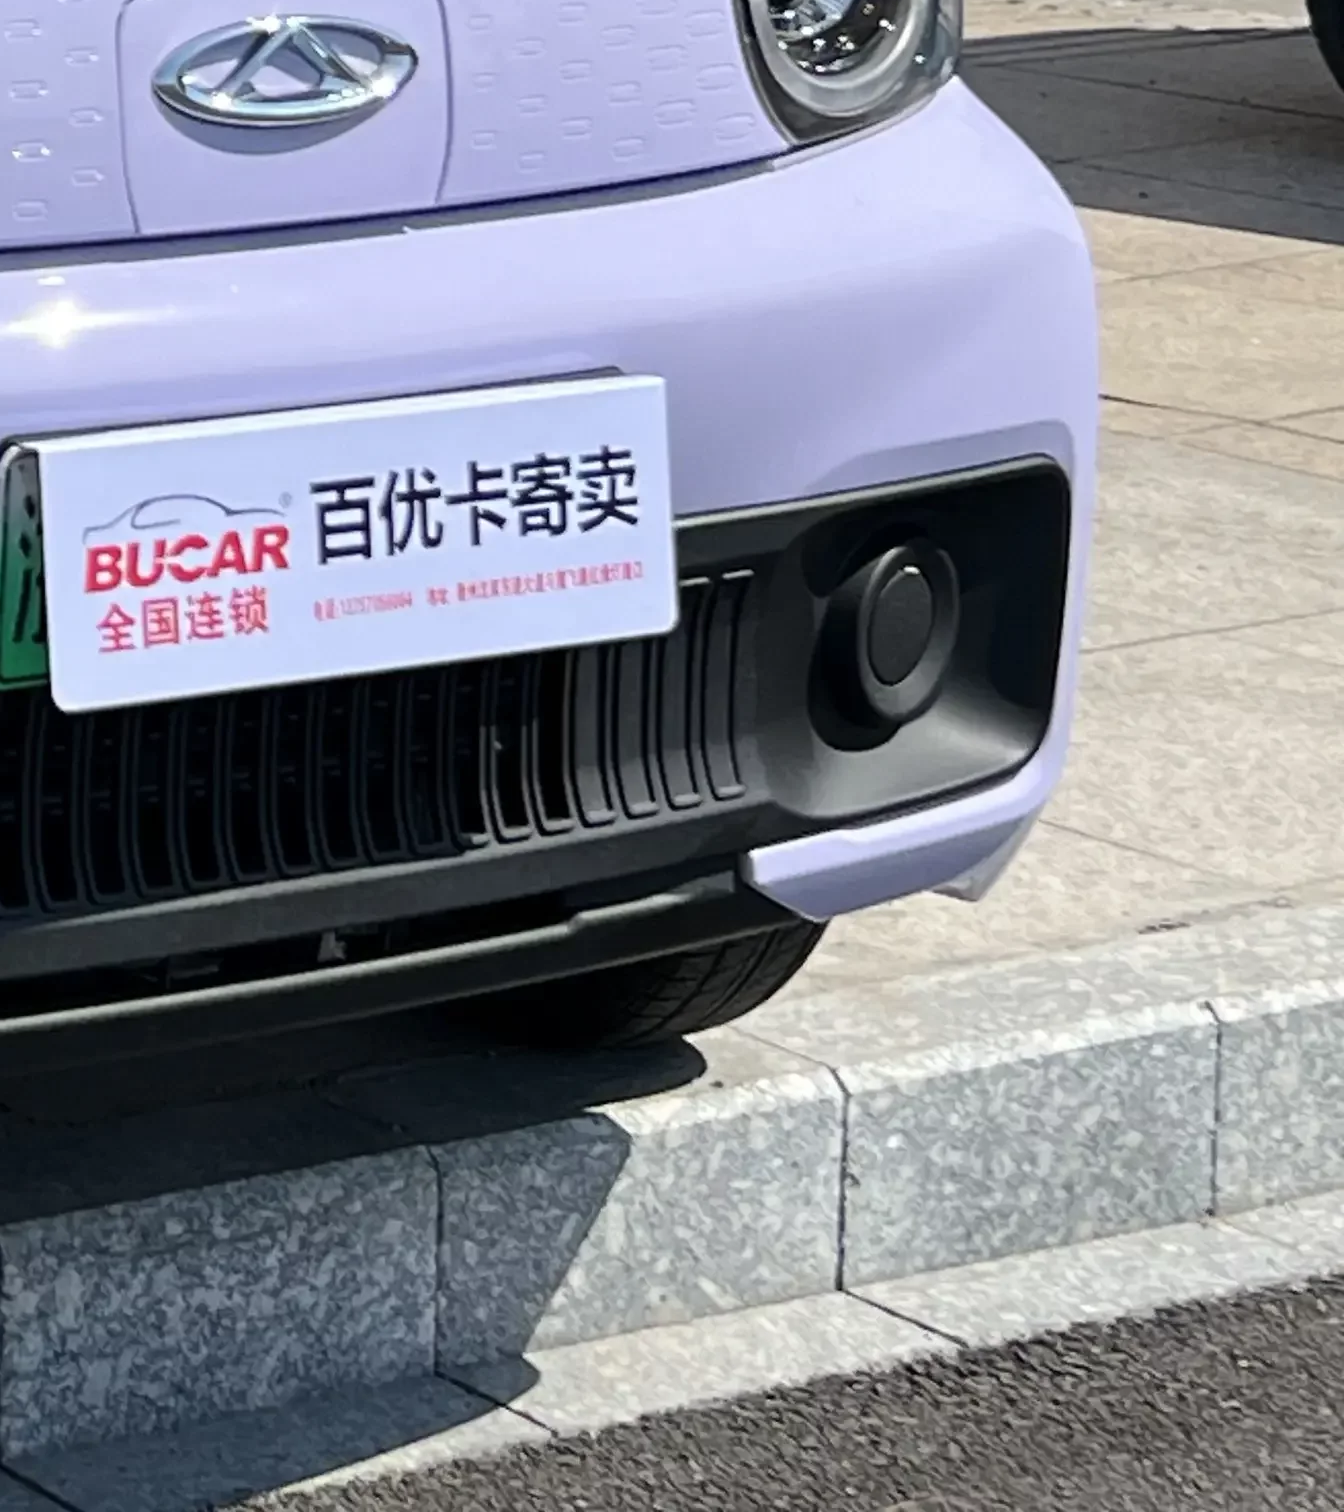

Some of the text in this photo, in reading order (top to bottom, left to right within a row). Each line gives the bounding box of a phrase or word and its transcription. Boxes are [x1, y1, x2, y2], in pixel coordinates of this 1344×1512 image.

[309, 444, 639, 565] 百优卡寄卖
[84, 523, 290, 593] BUCAR
[96, 585, 270, 654] 全国连锁
